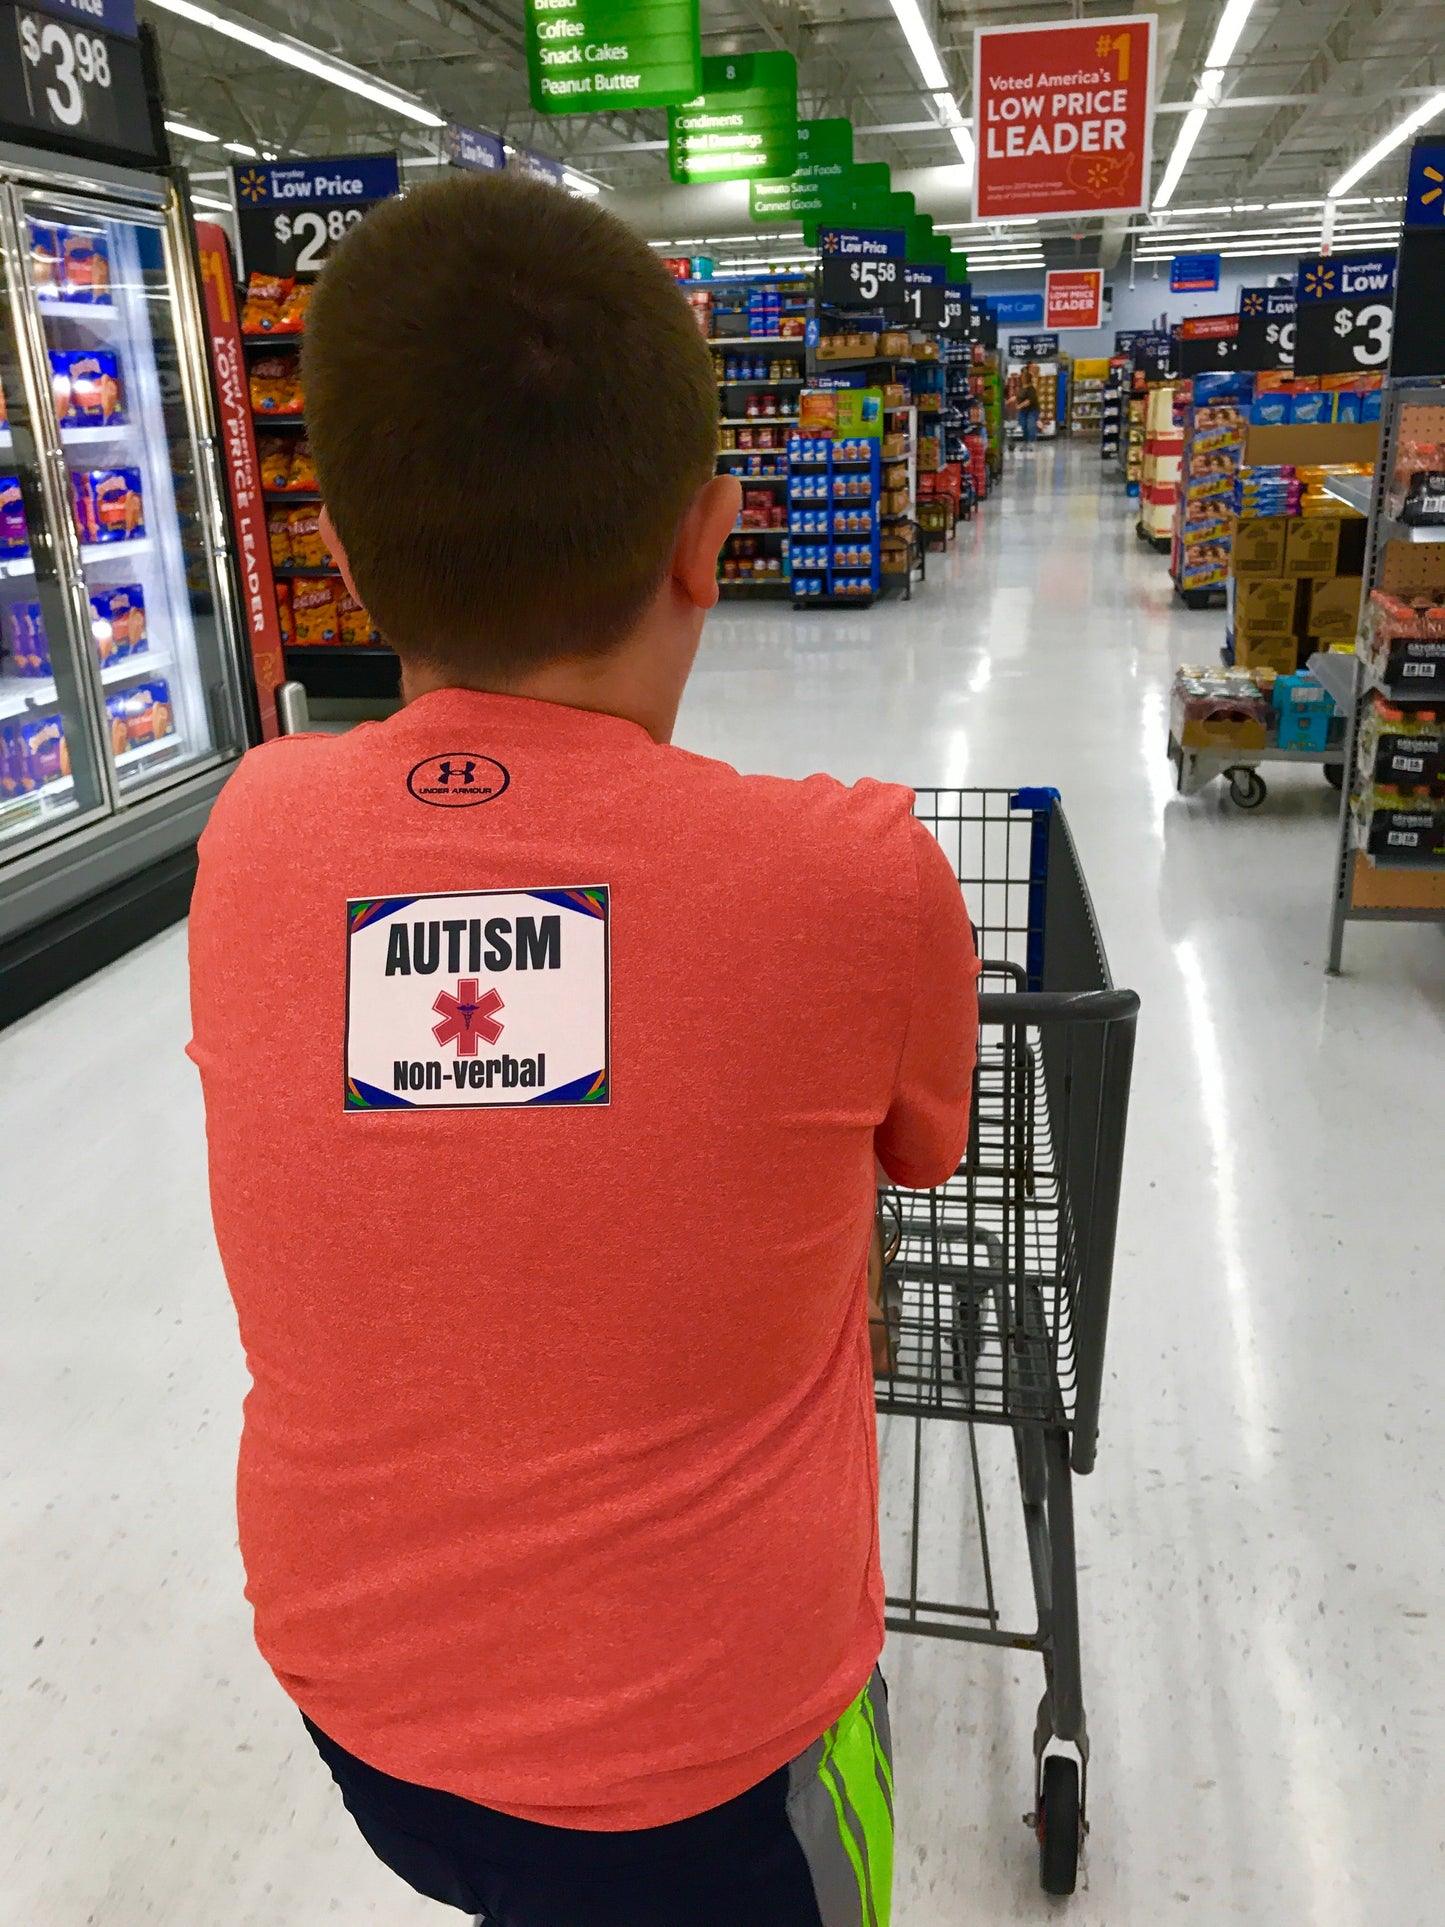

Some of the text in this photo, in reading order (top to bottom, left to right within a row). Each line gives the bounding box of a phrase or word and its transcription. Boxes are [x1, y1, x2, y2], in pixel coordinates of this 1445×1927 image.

[536, 19, 585, 40] Coffee
[539, 43, 629, 65] Snack Cakes
[1096, 33, 1131, 81] #1
[21, 16, 111, 125] $398
[726, 65, 736, 80] 8
[989, 68, 1111, 91] Voted America's
[541, 73, 641, 95] Peanut Butter
[987, 89, 1127, 121] LOW PRICE
[675, 114, 743, 129] Condiments
[987, 118, 1127, 159] LEADER
[814, 164, 842, 175] Foods
[272, 175, 364, 198] Low Price
[755, 182, 819, 195] Tomato Sauce
[755, 199, 822, 212] Canned Goods
[841, 240, 888, 254] Low Price
[1342, 262, 1383, 274] Everyday
[850, 262, 896, 300] $558
[1341, 273, 1388, 293] Low
[1048, 298, 1095, 311] LEADER
[808, 323, 818, 332] A
[1334, 303, 1394, 365] $3
[809, 335, 816, 347] 7
[213, 337, 265, 632] LOW PRICE LEADER
[385, 914, 562, 977] AUTISM
[393, 1053, 546, 1091] Non-verbal
